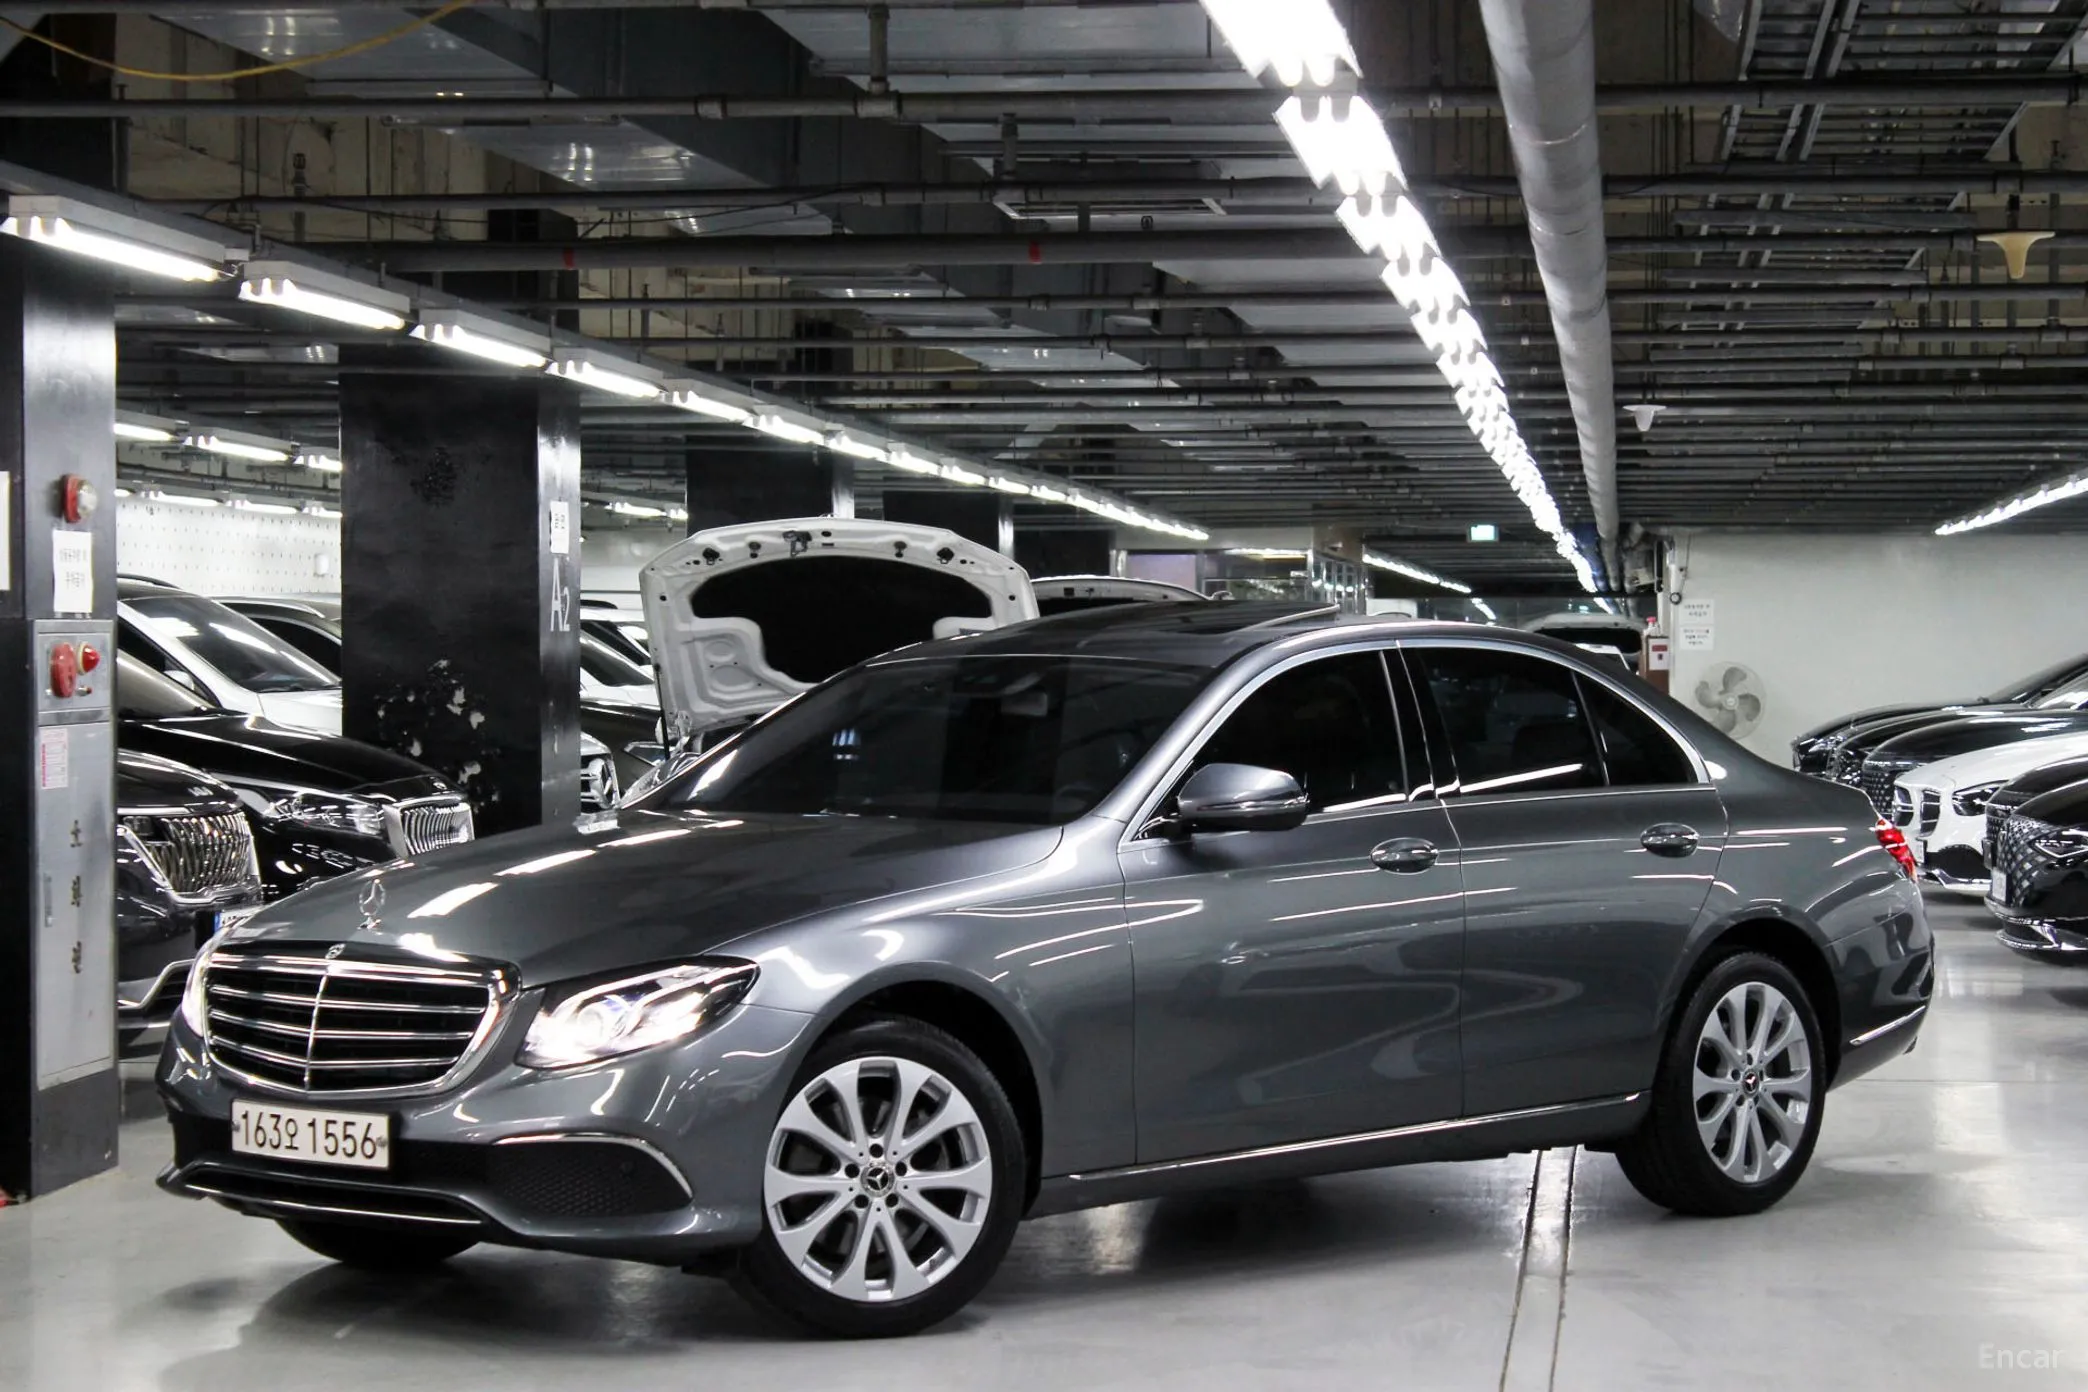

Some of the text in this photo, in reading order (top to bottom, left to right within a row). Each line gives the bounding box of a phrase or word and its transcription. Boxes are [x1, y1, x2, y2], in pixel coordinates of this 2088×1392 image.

[550, 557, 570, 632] A2
[241, 1110, 377, 1159] 163오 1556
